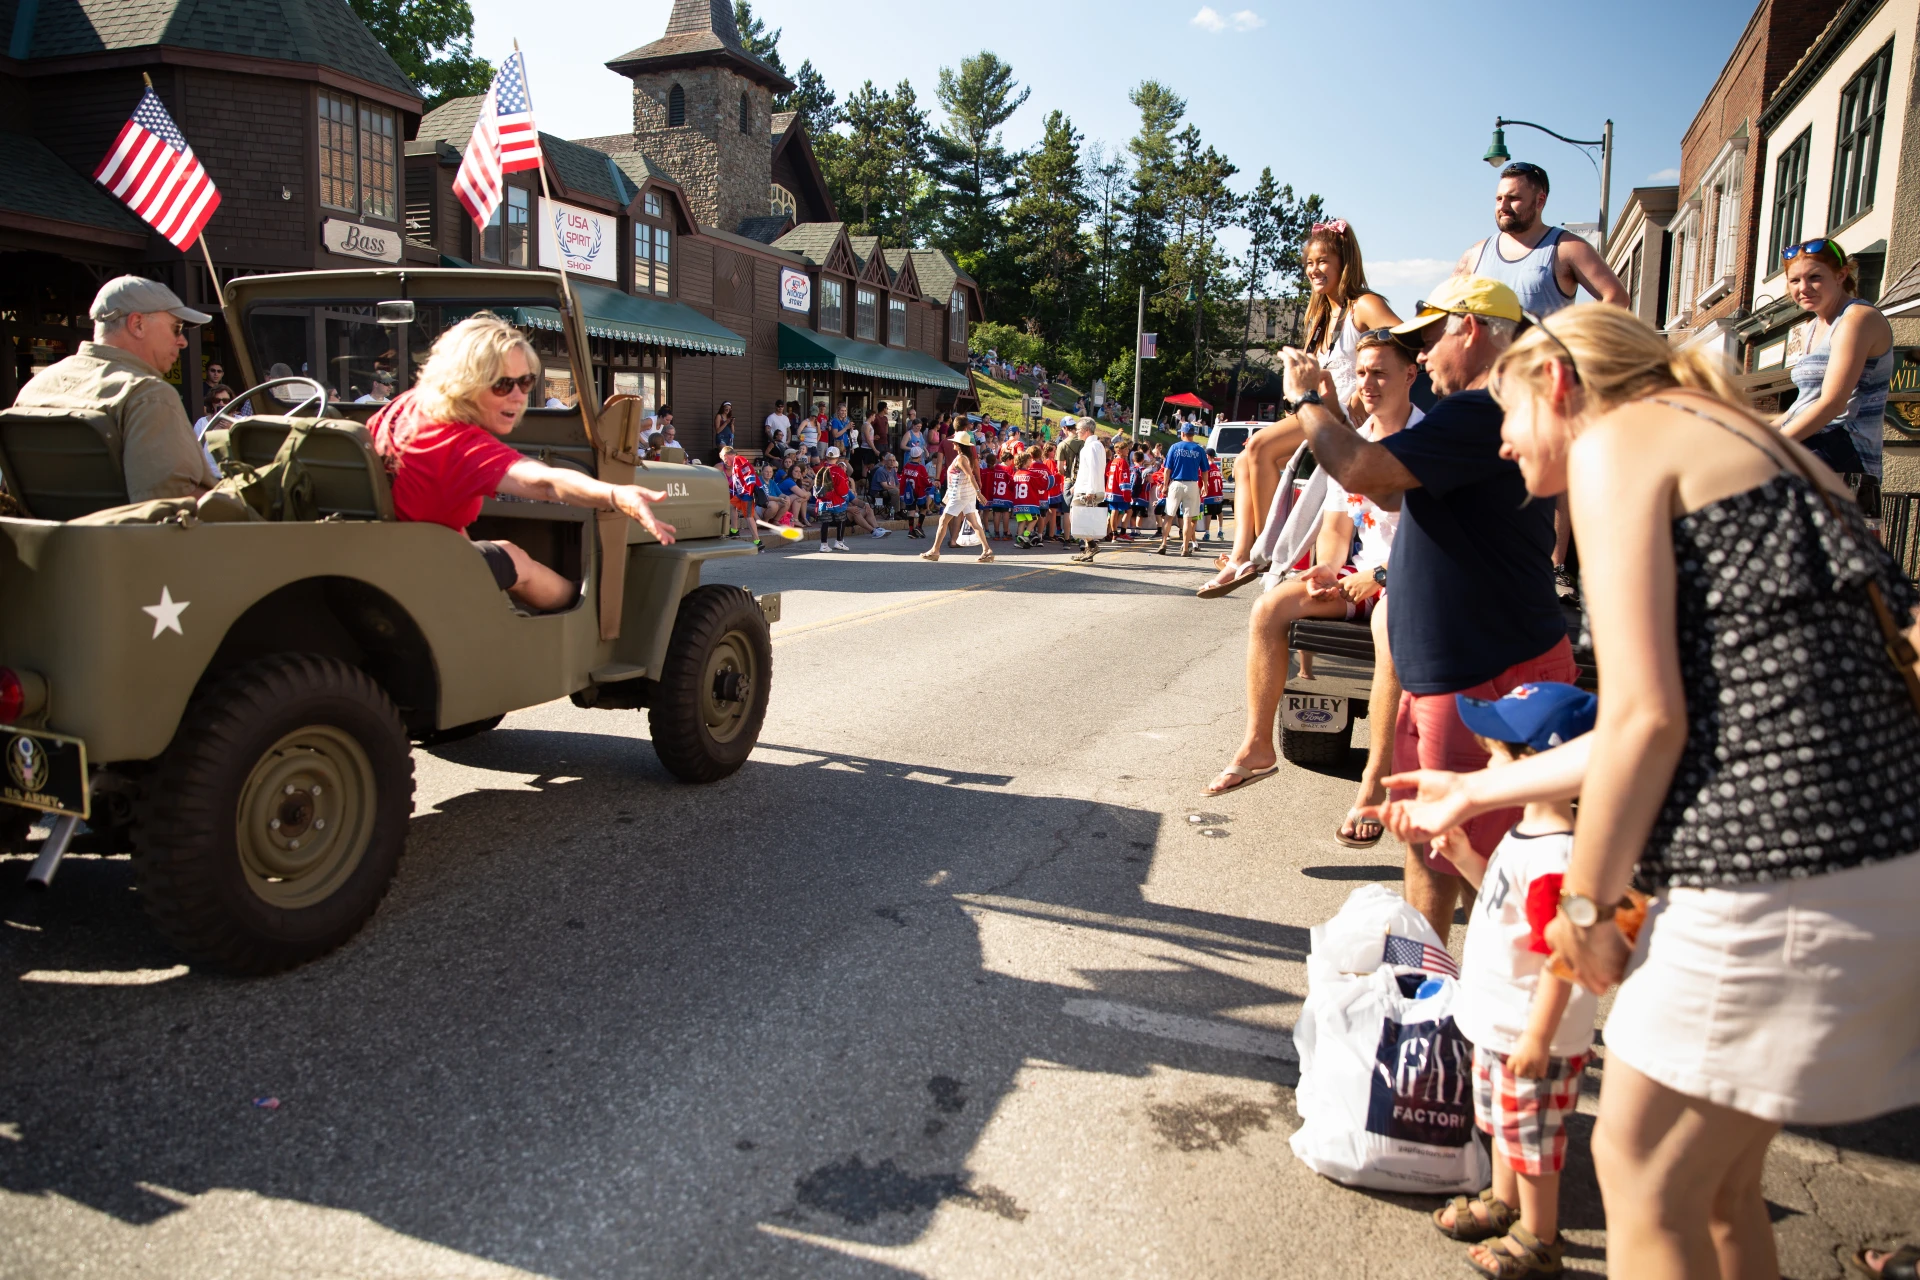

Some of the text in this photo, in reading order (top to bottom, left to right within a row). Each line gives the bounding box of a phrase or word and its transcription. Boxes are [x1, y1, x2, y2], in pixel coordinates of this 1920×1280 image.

[567, 213, 589, 231] USA
[340, 225, 387, 257] Bass
[566, 231, 591, 247] SPIRIT
[567, 260, 591, 271] SHOP
[789, 298, 802, 306] STORE
[667, 483, 689, 497] U.S.A.
[1015, 483, 1029, 499] 18
[1289, 697, 1342, 713] RILEY
[1301, 710, 1327, 722] Ford
[24, 791, 59, 807] ARMY
[1395, 1033, 1467, 1105] GAP
[1393, 1104, 1466, 1129] FACTORY
